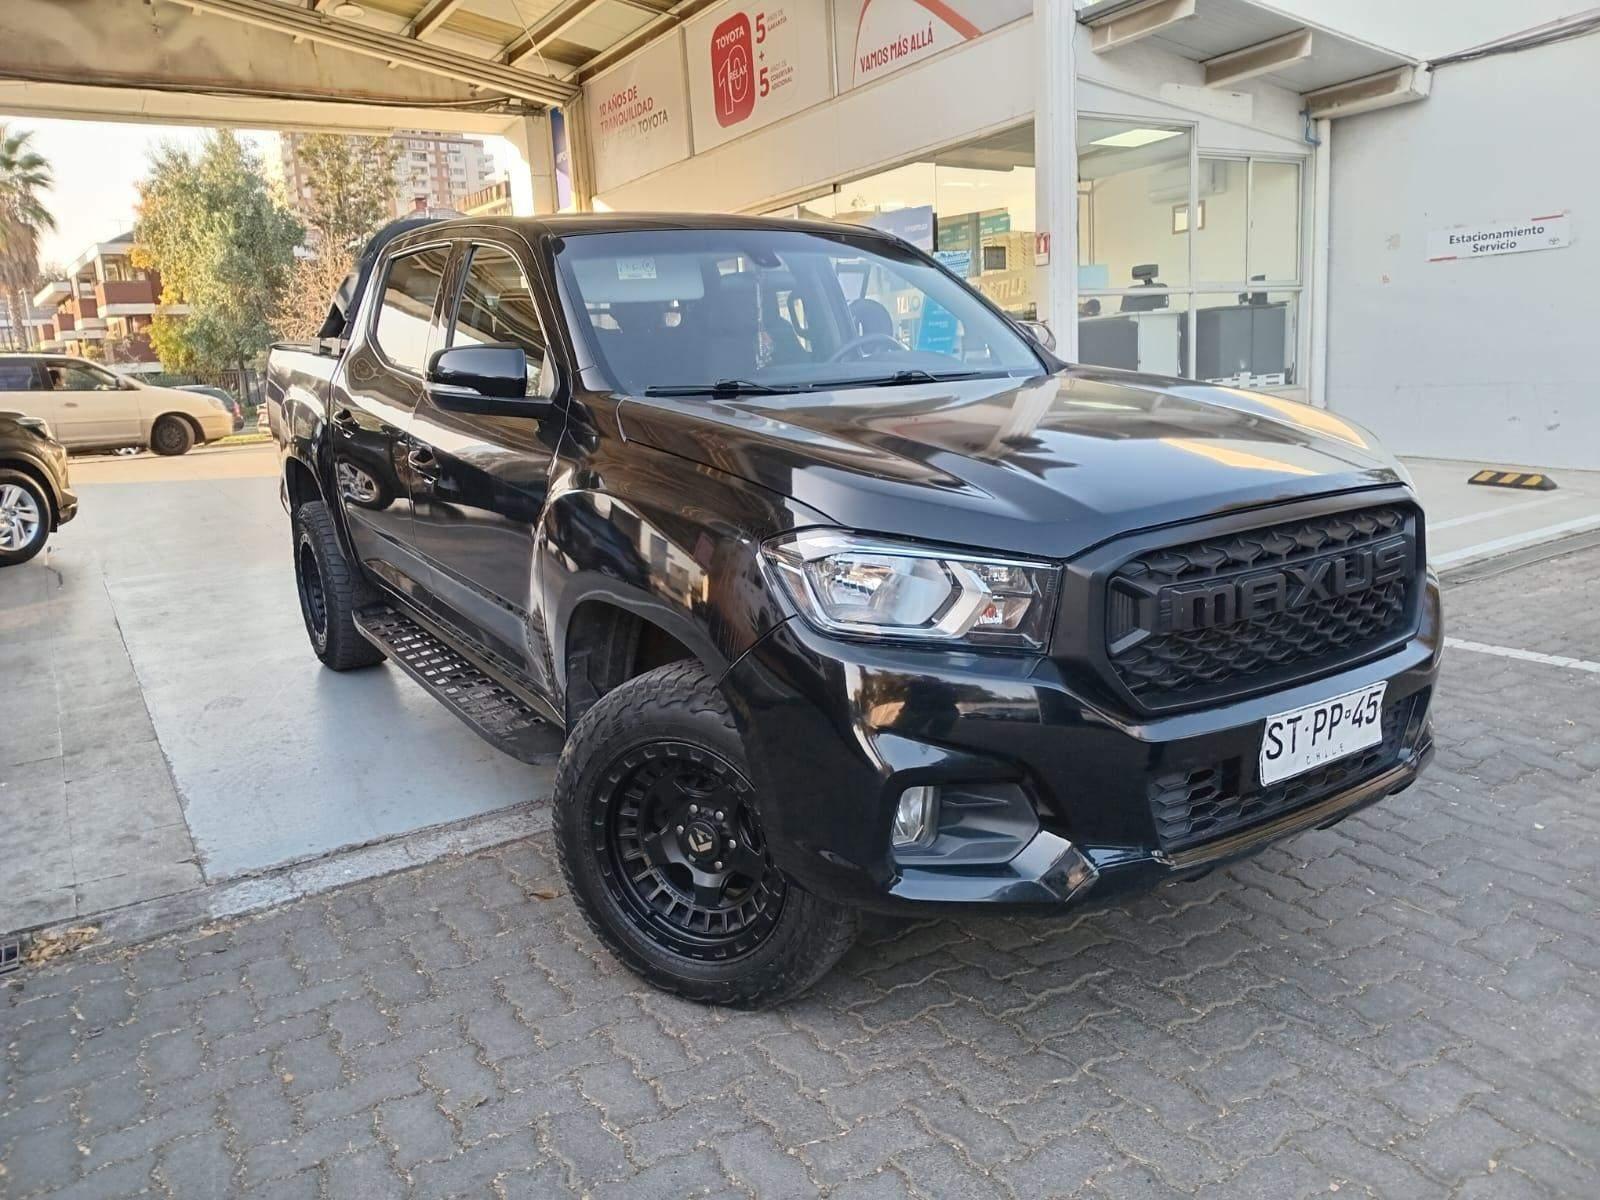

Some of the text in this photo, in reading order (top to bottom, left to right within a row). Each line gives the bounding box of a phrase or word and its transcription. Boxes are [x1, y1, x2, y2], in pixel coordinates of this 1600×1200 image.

[716, 26, 745, 50] TOYOTA
[756, 12, 766, 44] 5
[860, 20, 933, 73] VAMOS MÁS ALLÁ
[718, 44, 748, 115] 10
[729, 63, 747, 81] RELAX
[760, 66, 770, 98] 5
[599, 85, 638, 117] 10 AÑOS DE
[600, 96, 654, 134] TRANQUILIDAD
[638, 109, 669, 134] TOYOTA
[1449, 225, 1545, 245] Estacionamiento
[1472, 239, 1518, 253] Servicio
[1160, 538, 1407, 634] MAXUS
